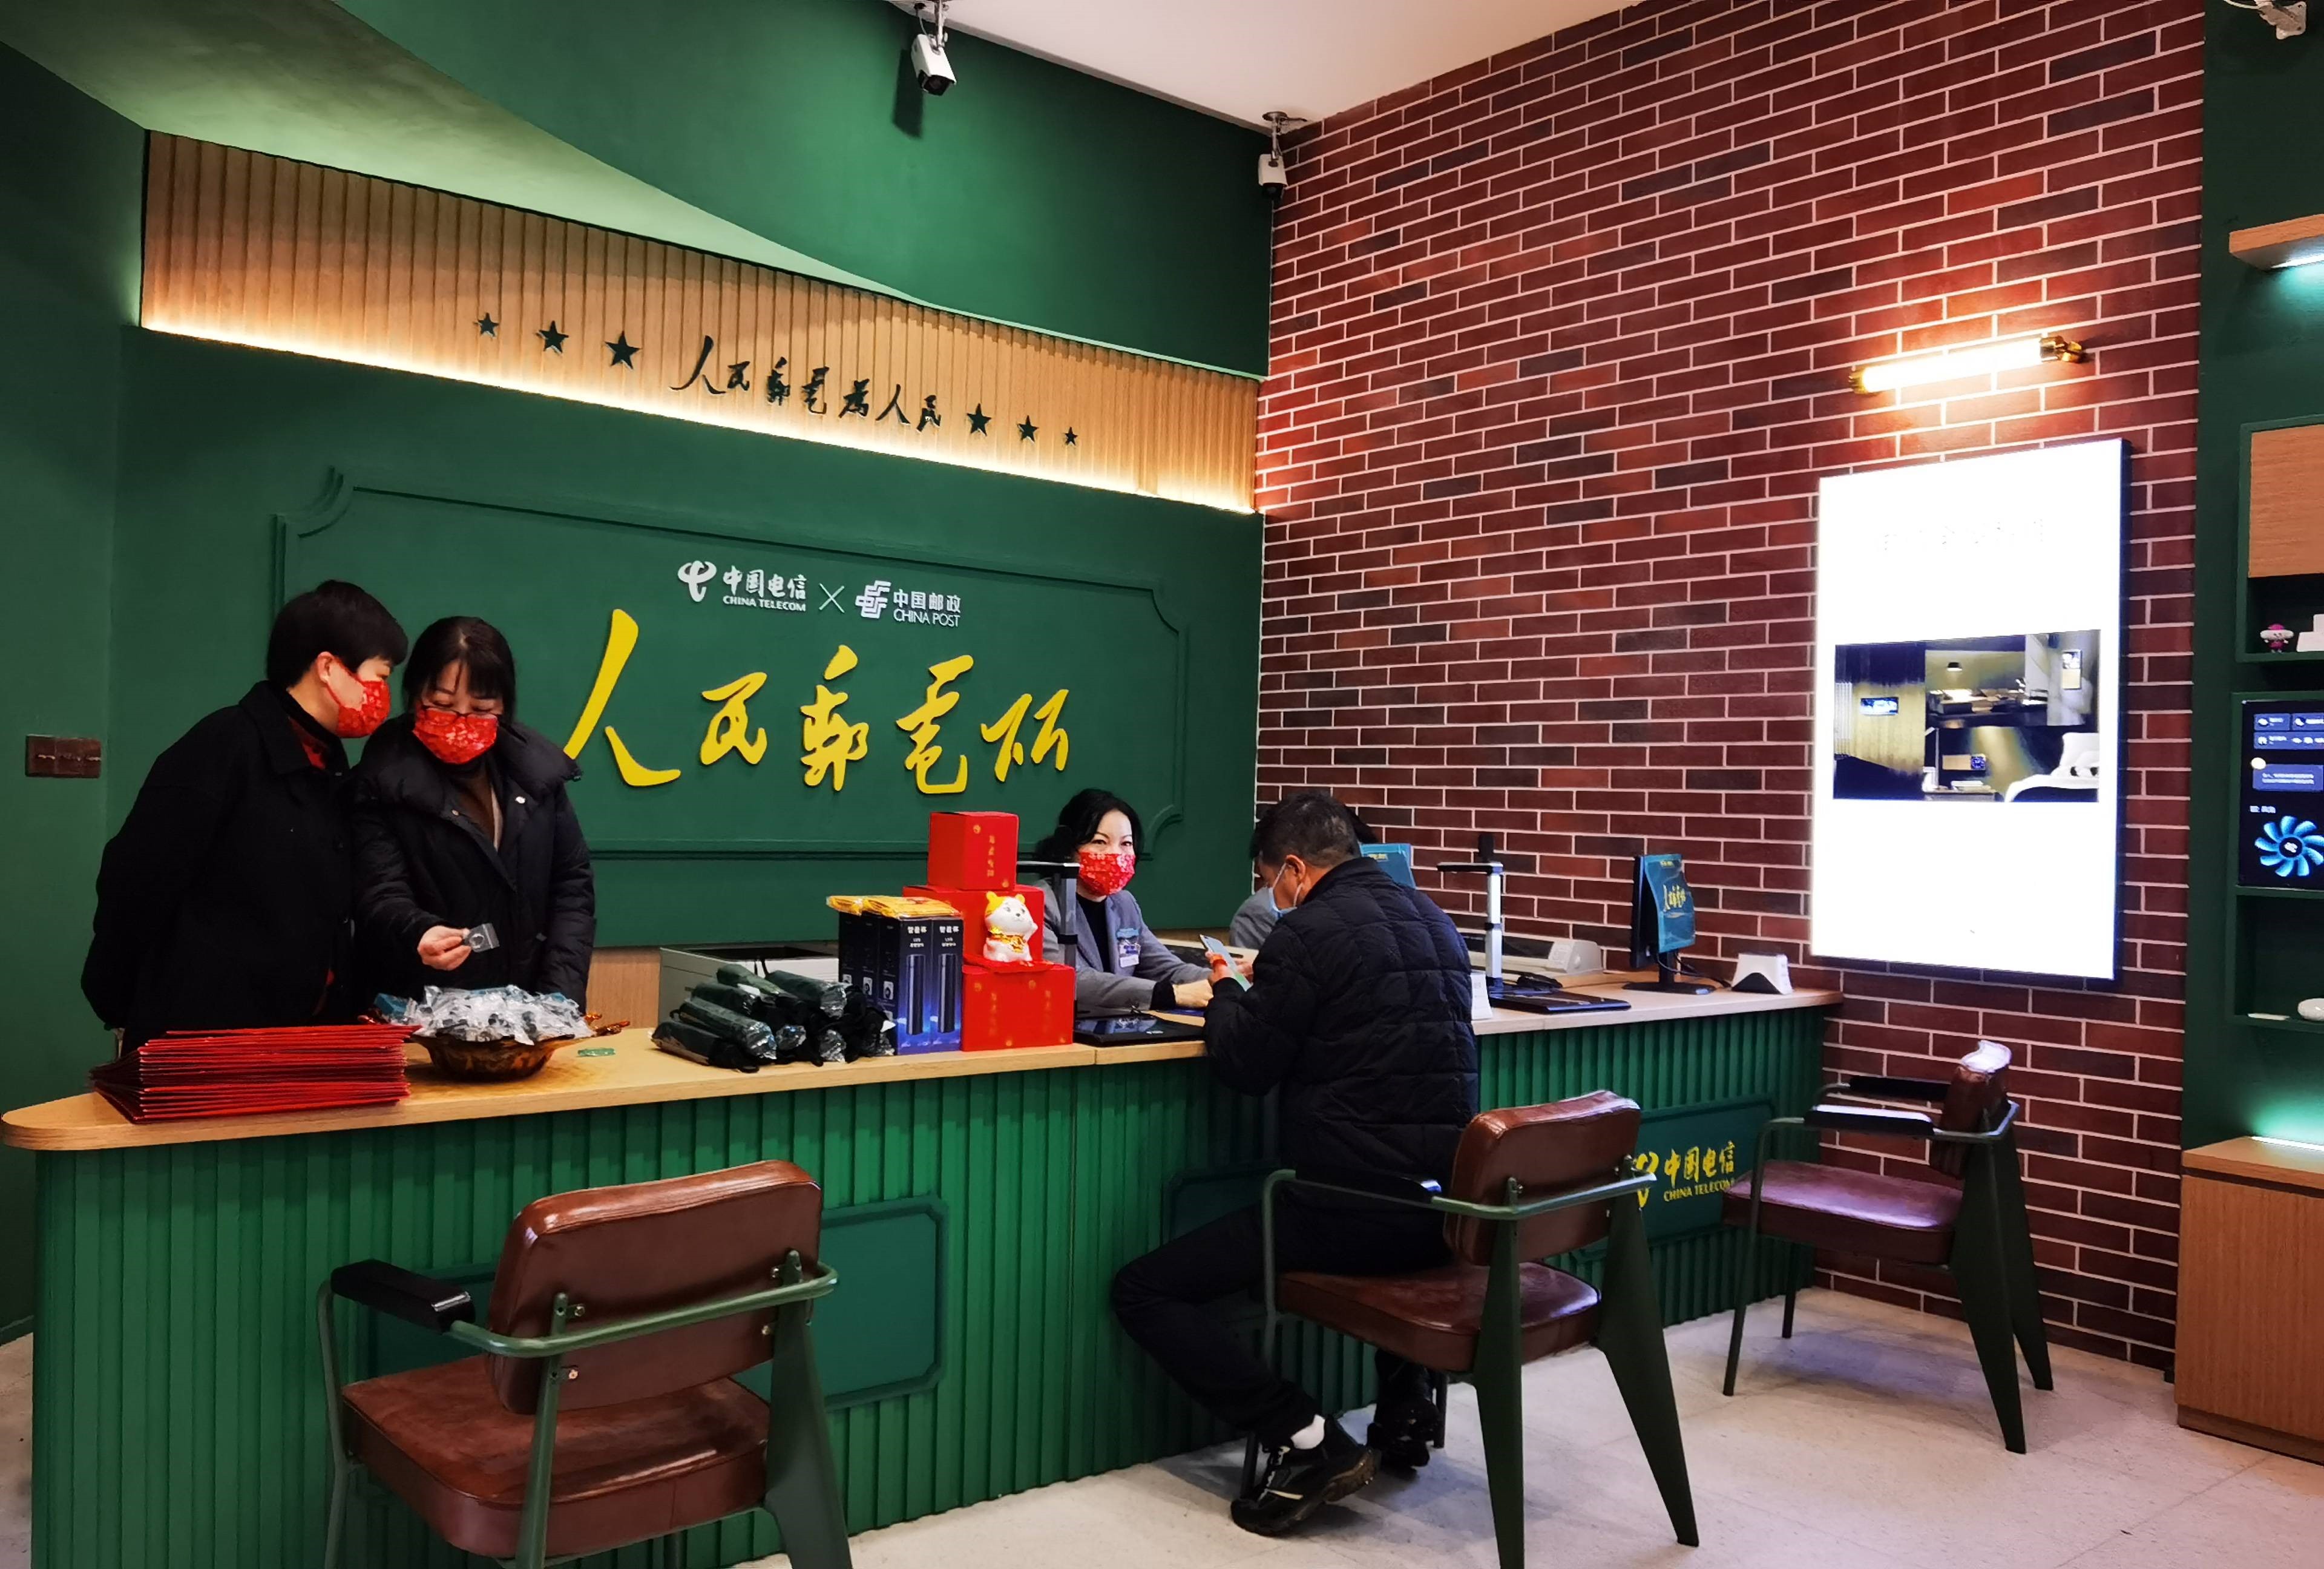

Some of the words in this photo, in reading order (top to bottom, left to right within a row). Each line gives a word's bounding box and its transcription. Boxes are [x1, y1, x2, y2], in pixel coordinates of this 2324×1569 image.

[723, 565, 808, 599] 中国电信
[722, 595, 757, 608] CHINA
[758, 599, 806, 613] TELECOM
[893, 588, 962, 614] 中国邮政
[893, 608, 931, 625] CHINA
[932, 612, 961, 628] POST
[1663, 1186, 1693, 1202] CHINA
